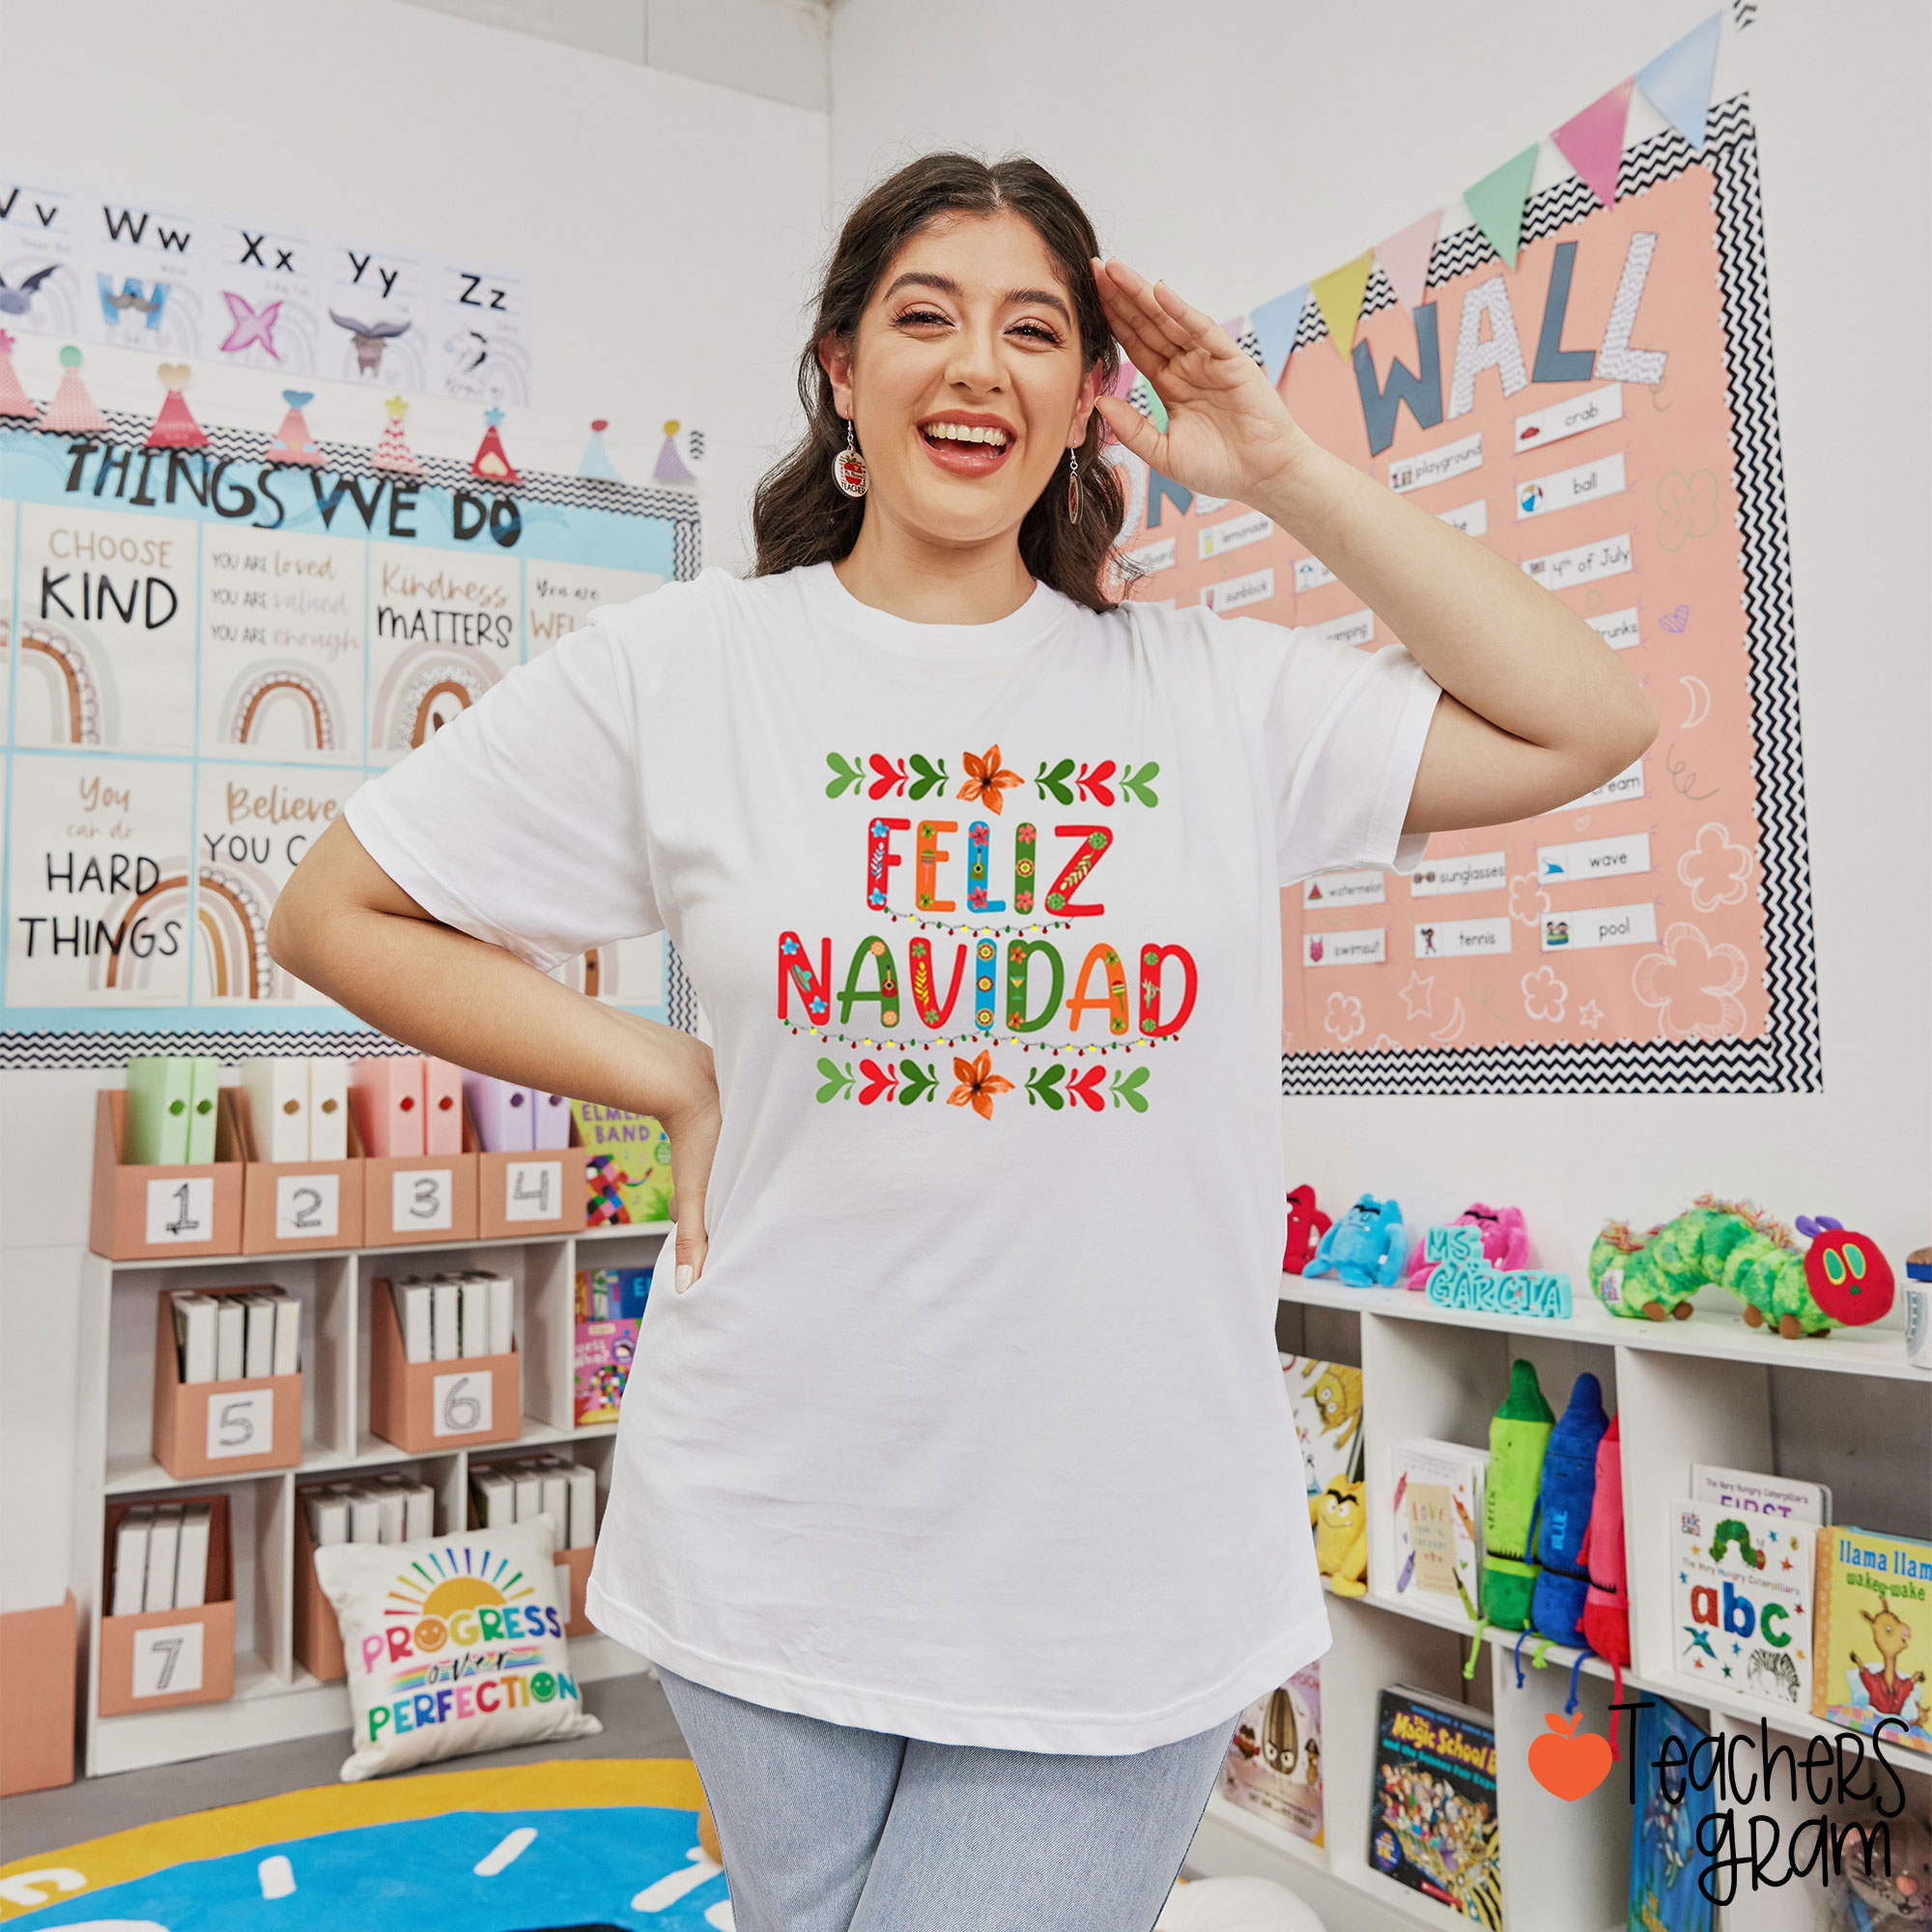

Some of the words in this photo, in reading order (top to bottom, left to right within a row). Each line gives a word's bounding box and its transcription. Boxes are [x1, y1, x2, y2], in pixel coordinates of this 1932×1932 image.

[1352, 231, 1669, 458] WALL
[1564, 401, 1600, 427] crab
[1414, 438, 1484, 481] playground
[65, 442, 286, 529] THINGS
[309, 469, 423, 539] WE
[452, 489, 523, 548] DO
[1572, 471, 1600, 496] ball
[48, 527, 174, 570] CHOOSE
[1222, 519, 1269, 544] lemonade
[211, 551, 241, 571] YOU
[243, 554, 268, 574] ARE
[272, 549, 338, 582] loved
[1577, 552, 1595, 574] of
[1600, 545, 1632, 567] July
[41, 565, 179, 631] KIND
[210, 586, 240, 608] YOU
[242, 590, 268, 610] ARE
[382, 559, 510, 610] Kindness
[1225, 580, 1268, 604] sunblock
[210, 623, 240, 642] YOU
[242, 626, 267, 646] ARE
[271, 626, 360, 663] enough
[78, 775, 132, 812] You
[225, 781, 340, 826] Believe
[67, 822, 101, 839] can
[203, 833, 270, 864] YOU
[45, 850, 161, 897] HARD
[866, 816, 1114, 918] FELIZ
[1439, 863, 1506, 886] sunglasses
[1588, 852, 1629, 868] wave
[1328, 881, 1384, 897] watermelon
[17, 914, 184, 958] THINGS
[1333, 940, 1380, 957] swimsuit
[1459, 929, 1497, 947] tennis
[1599, 915, 1631, 942] pool
[777, 930, 1199, 1037] NAVIDAD
[595, 1124, 650, 1144] BAND
[165, 1181, 200, 1236] 1
[292, 1186, 324, 1230] 2
[410, 1177, 440, 1219] 3
[512, 1168, 550, 1212] 4
[1428, 1264, 1565, 1319] GARCIA
[218, 1401, 255, 1447] 5
[442, 1377, 482, 1431] 6
[1838, 1538, 1889, 1573] llama
[361, 1604, 562, 1675] PROGRESS
[150, 1636, 185, 1690] 7
[427, 1651, 530, 1685] over
[368, 1670, 579, 1744] PERFECTION
[1391, 1709, 1436, 1749] Magic
[1435, 1726, 1489, 1771] School
